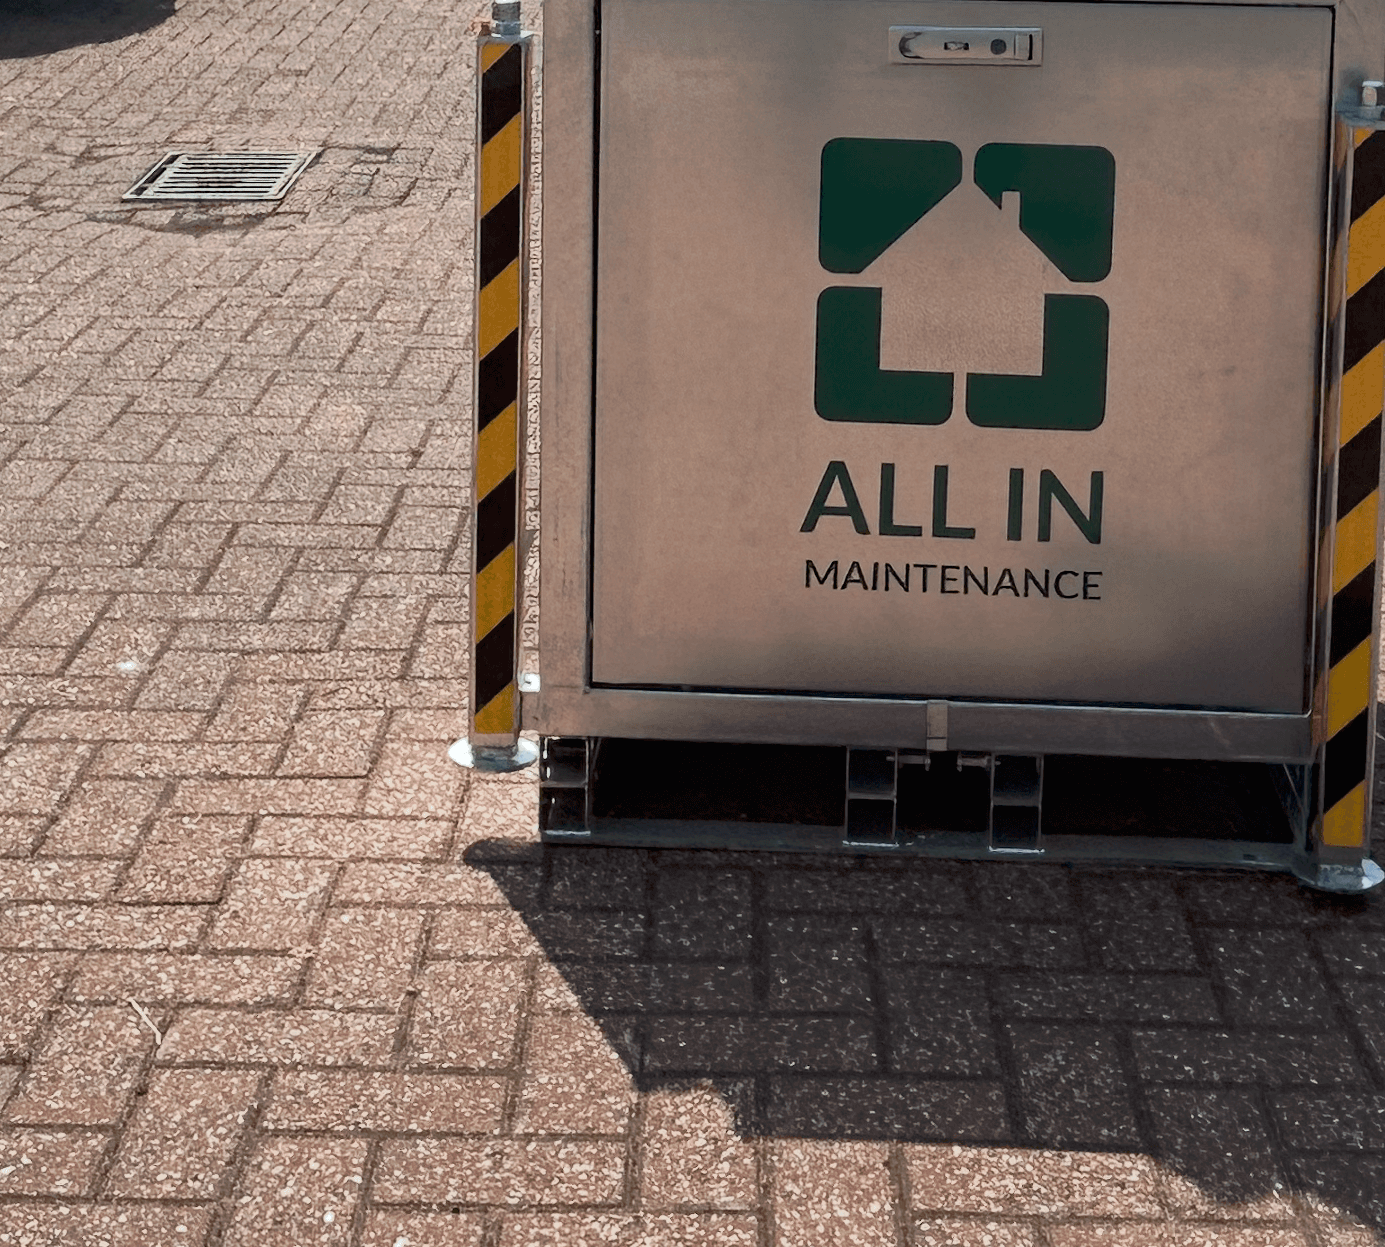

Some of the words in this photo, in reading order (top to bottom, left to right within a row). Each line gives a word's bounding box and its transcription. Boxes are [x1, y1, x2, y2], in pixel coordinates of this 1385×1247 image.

[800, 460, 976, 540] ALL
[1007, 467, 1104, 545] IN
[805, 559, 1103, 600] MAINTENANCE
